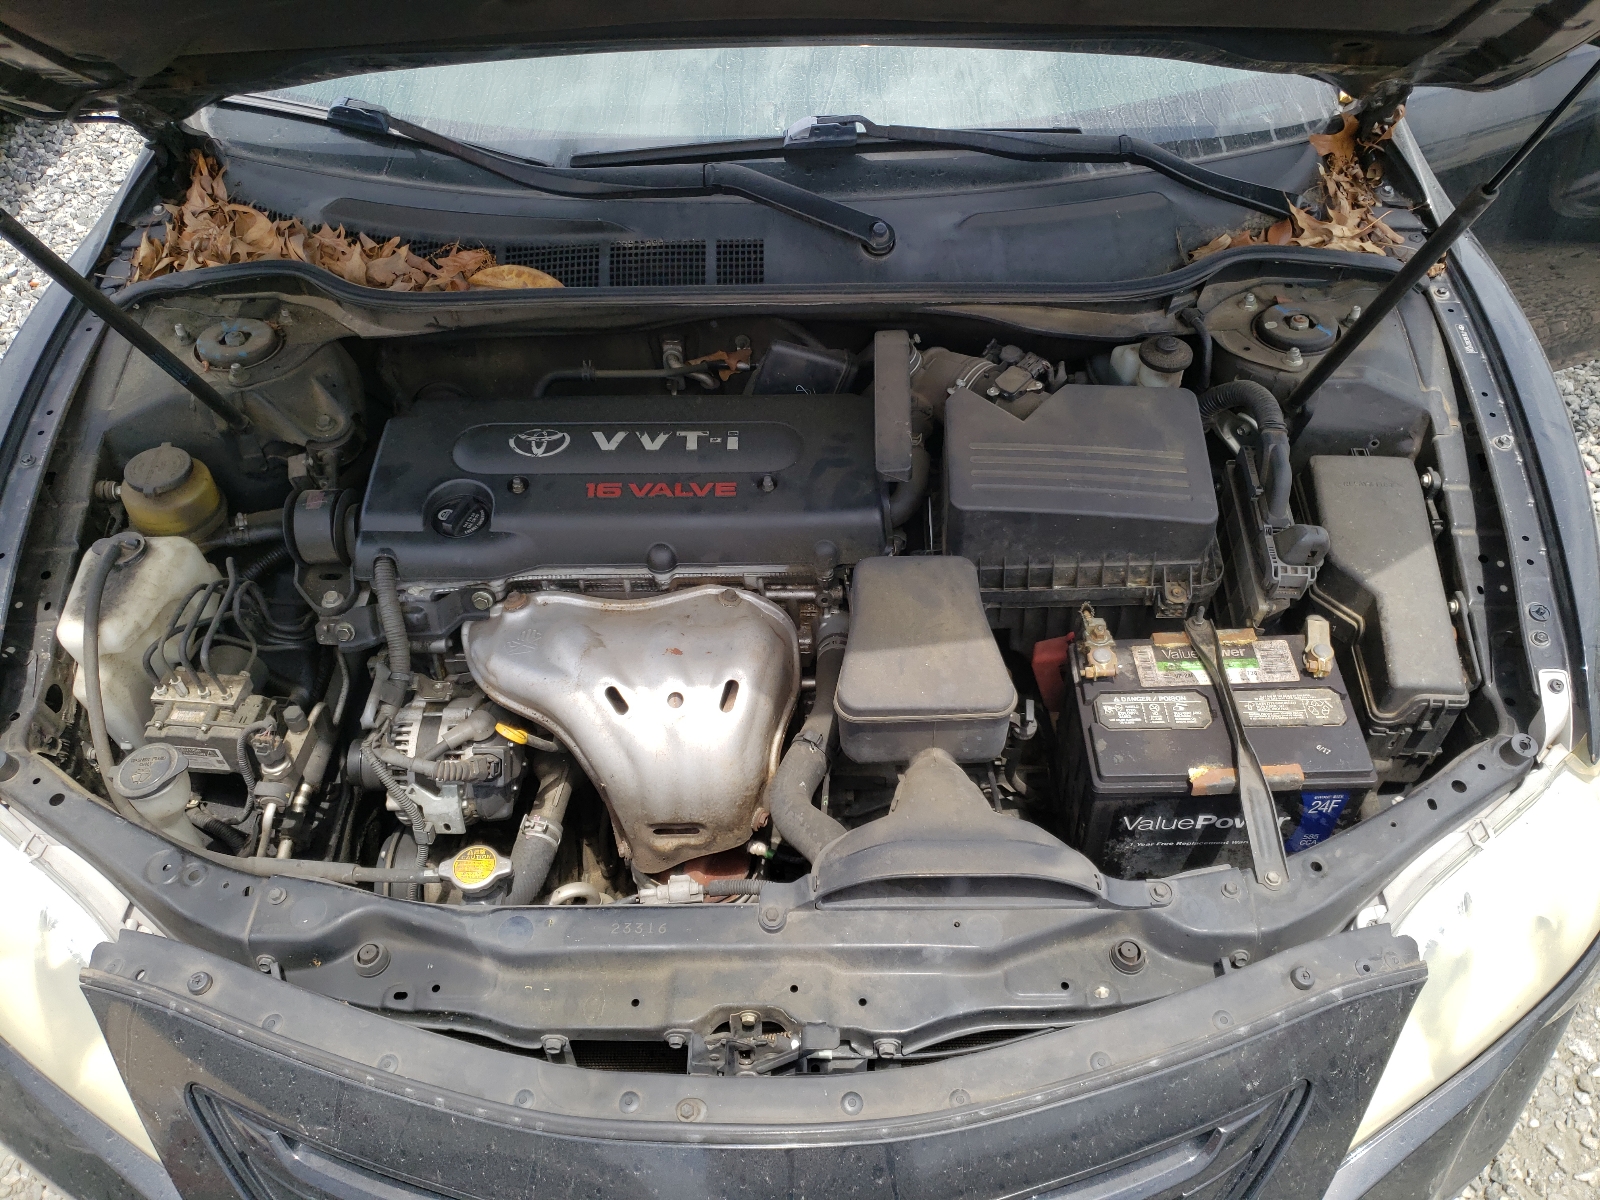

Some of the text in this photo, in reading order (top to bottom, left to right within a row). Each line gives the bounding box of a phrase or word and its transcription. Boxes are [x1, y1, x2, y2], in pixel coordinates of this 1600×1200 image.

[591, 430, 739, 451] VVT-i
[586, 482, 738, 498] 16 VALVE
[1308, 800, 1342, 814] 24F
[610, 922, 667, 934] 23316
